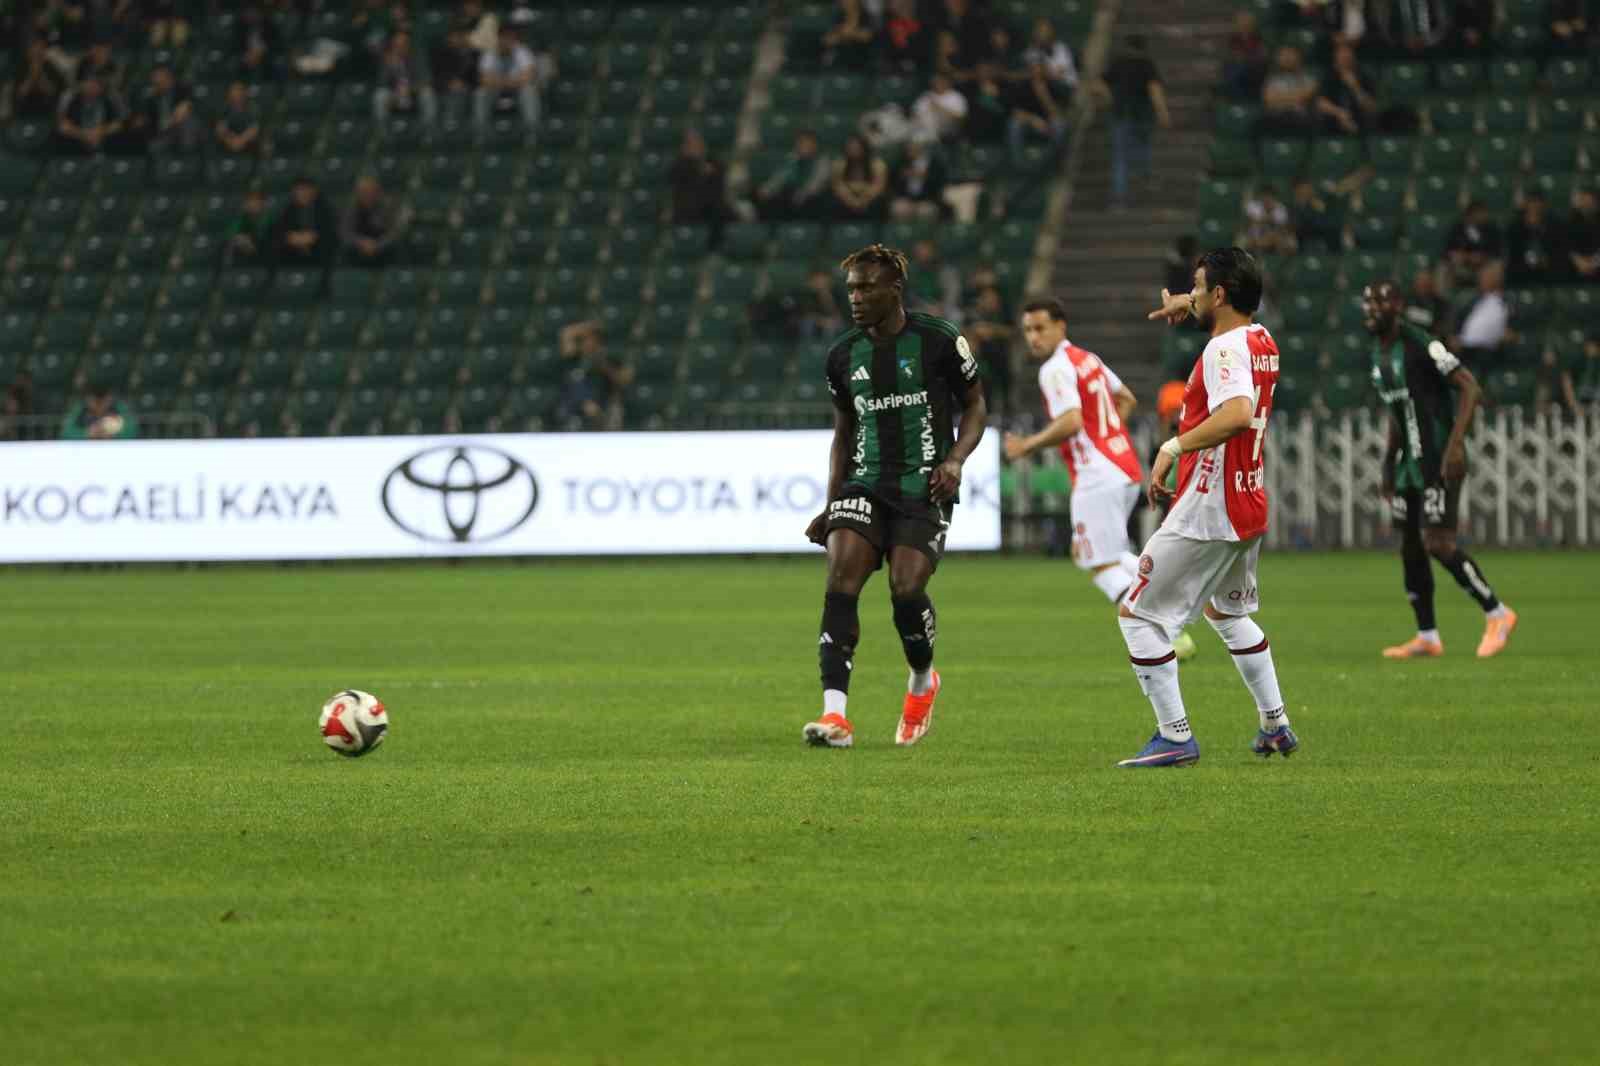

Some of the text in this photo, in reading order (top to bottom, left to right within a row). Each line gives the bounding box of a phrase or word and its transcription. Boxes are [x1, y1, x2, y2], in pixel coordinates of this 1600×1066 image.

[867, 390, 929, 411] SAFİPORT
[3, 473, 339, 523] KOCAELİ KAYA
[563, 477, 738, 513] TOYOTA
[753, 478, 829, 512] KO
[830, 497, 872, 514] nuh
